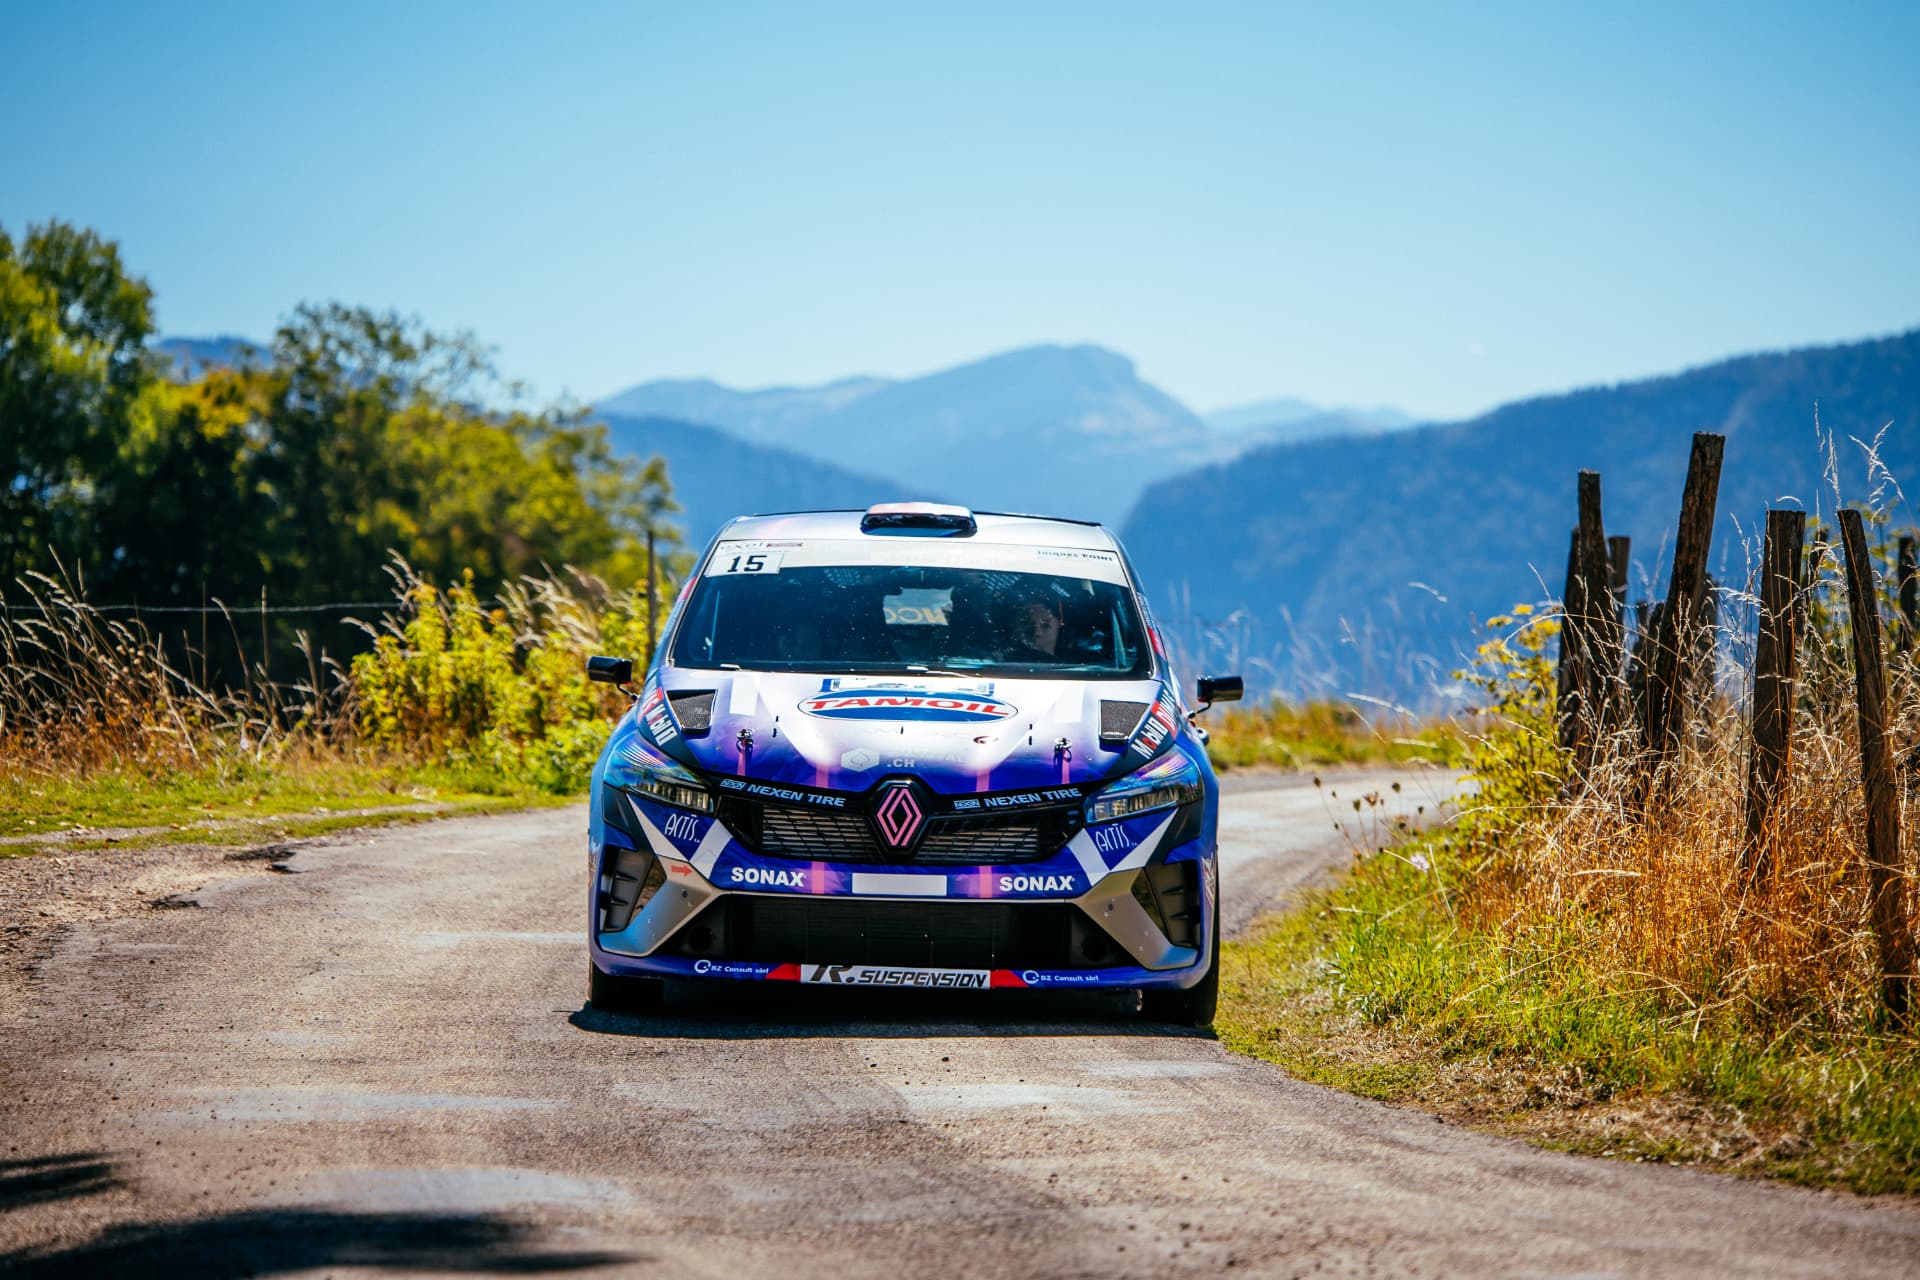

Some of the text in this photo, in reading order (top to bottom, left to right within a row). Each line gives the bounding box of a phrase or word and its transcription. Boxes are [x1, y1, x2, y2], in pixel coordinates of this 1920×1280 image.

[727, 554, 768, 573] 15
[806, 698, 1009, 716] TAMOIL
[747, 784, 804, 801] NEXEN
[807, 793, 846, 807] TIRE
[984, 792, 1041, 808] NEXEN
[1042, 787, 1082, 800] TIRE
[731, 866, 804, 887] SONAX
[999, 875, 1072, 892] SONAX
[858, 970, 987, 987] SUSPENSION
